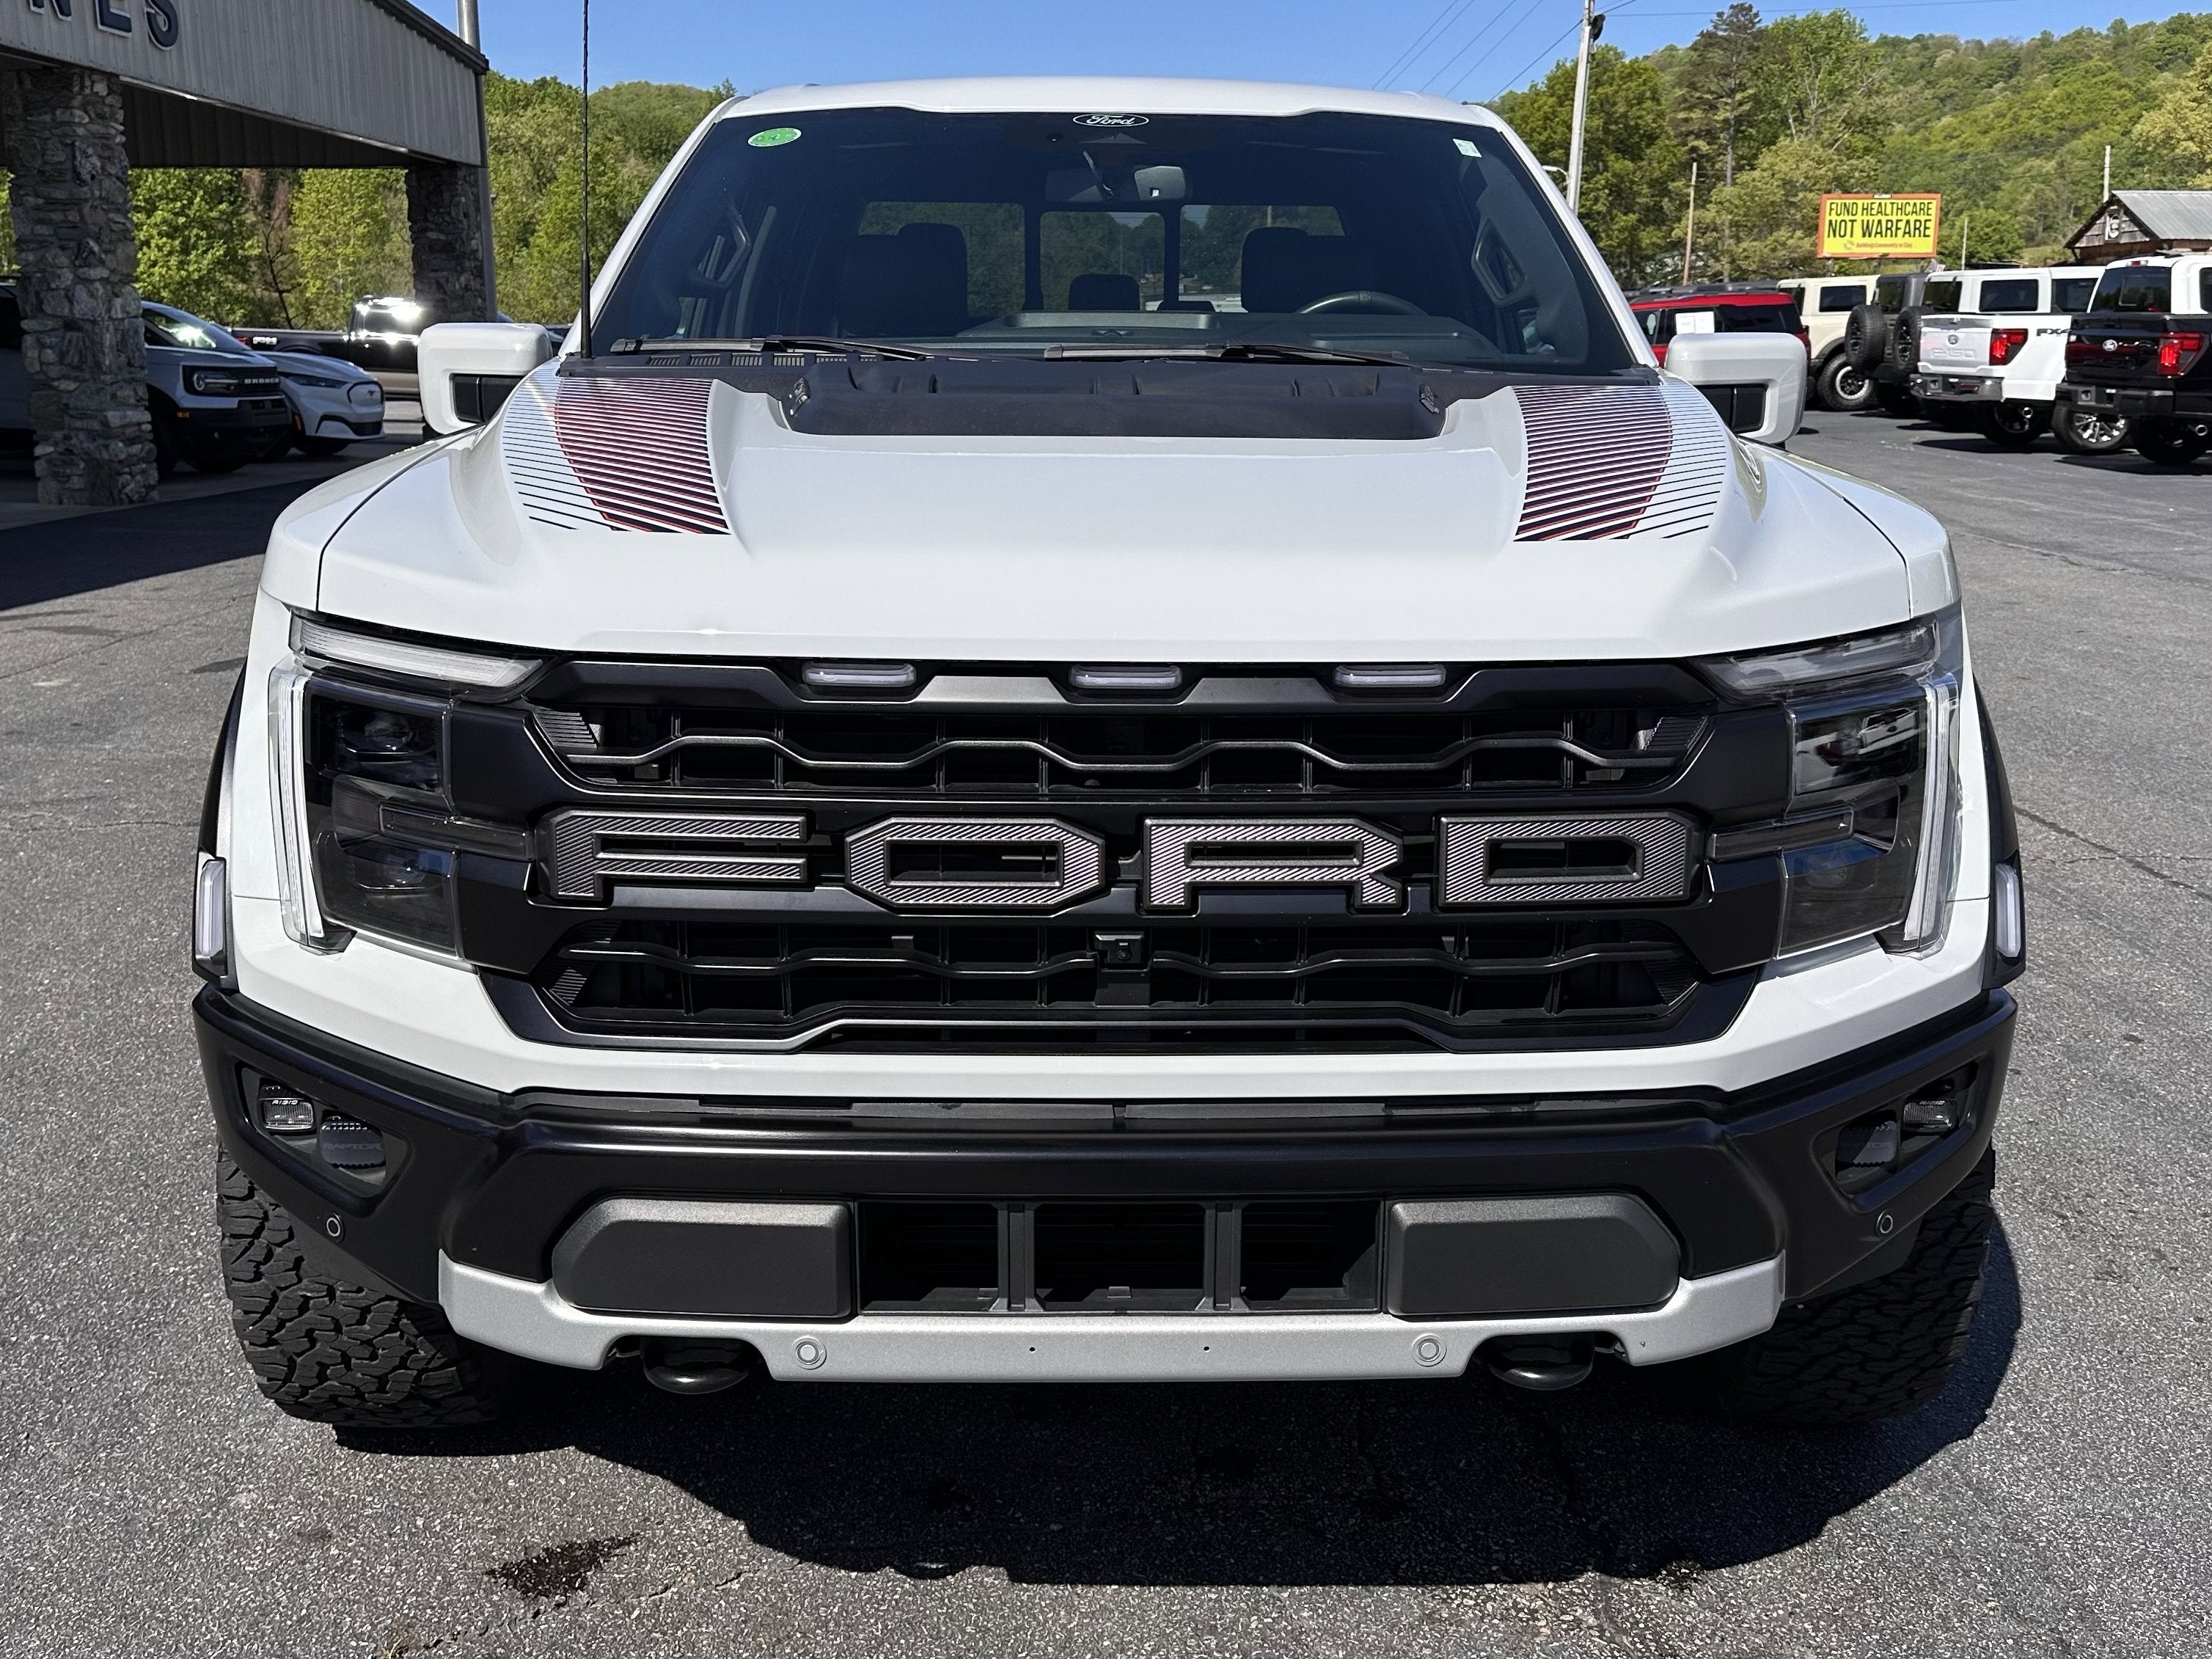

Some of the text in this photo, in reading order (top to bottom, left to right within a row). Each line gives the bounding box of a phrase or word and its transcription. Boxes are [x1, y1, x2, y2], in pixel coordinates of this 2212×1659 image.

[1086, 114, 1136, 125] Ford
[1828, 202, 1933, 216] FUND HEALTHCARE
[1827, 219, 1931, 238] NOT WARFARE
[544, 808, 1696, 912] FORD
